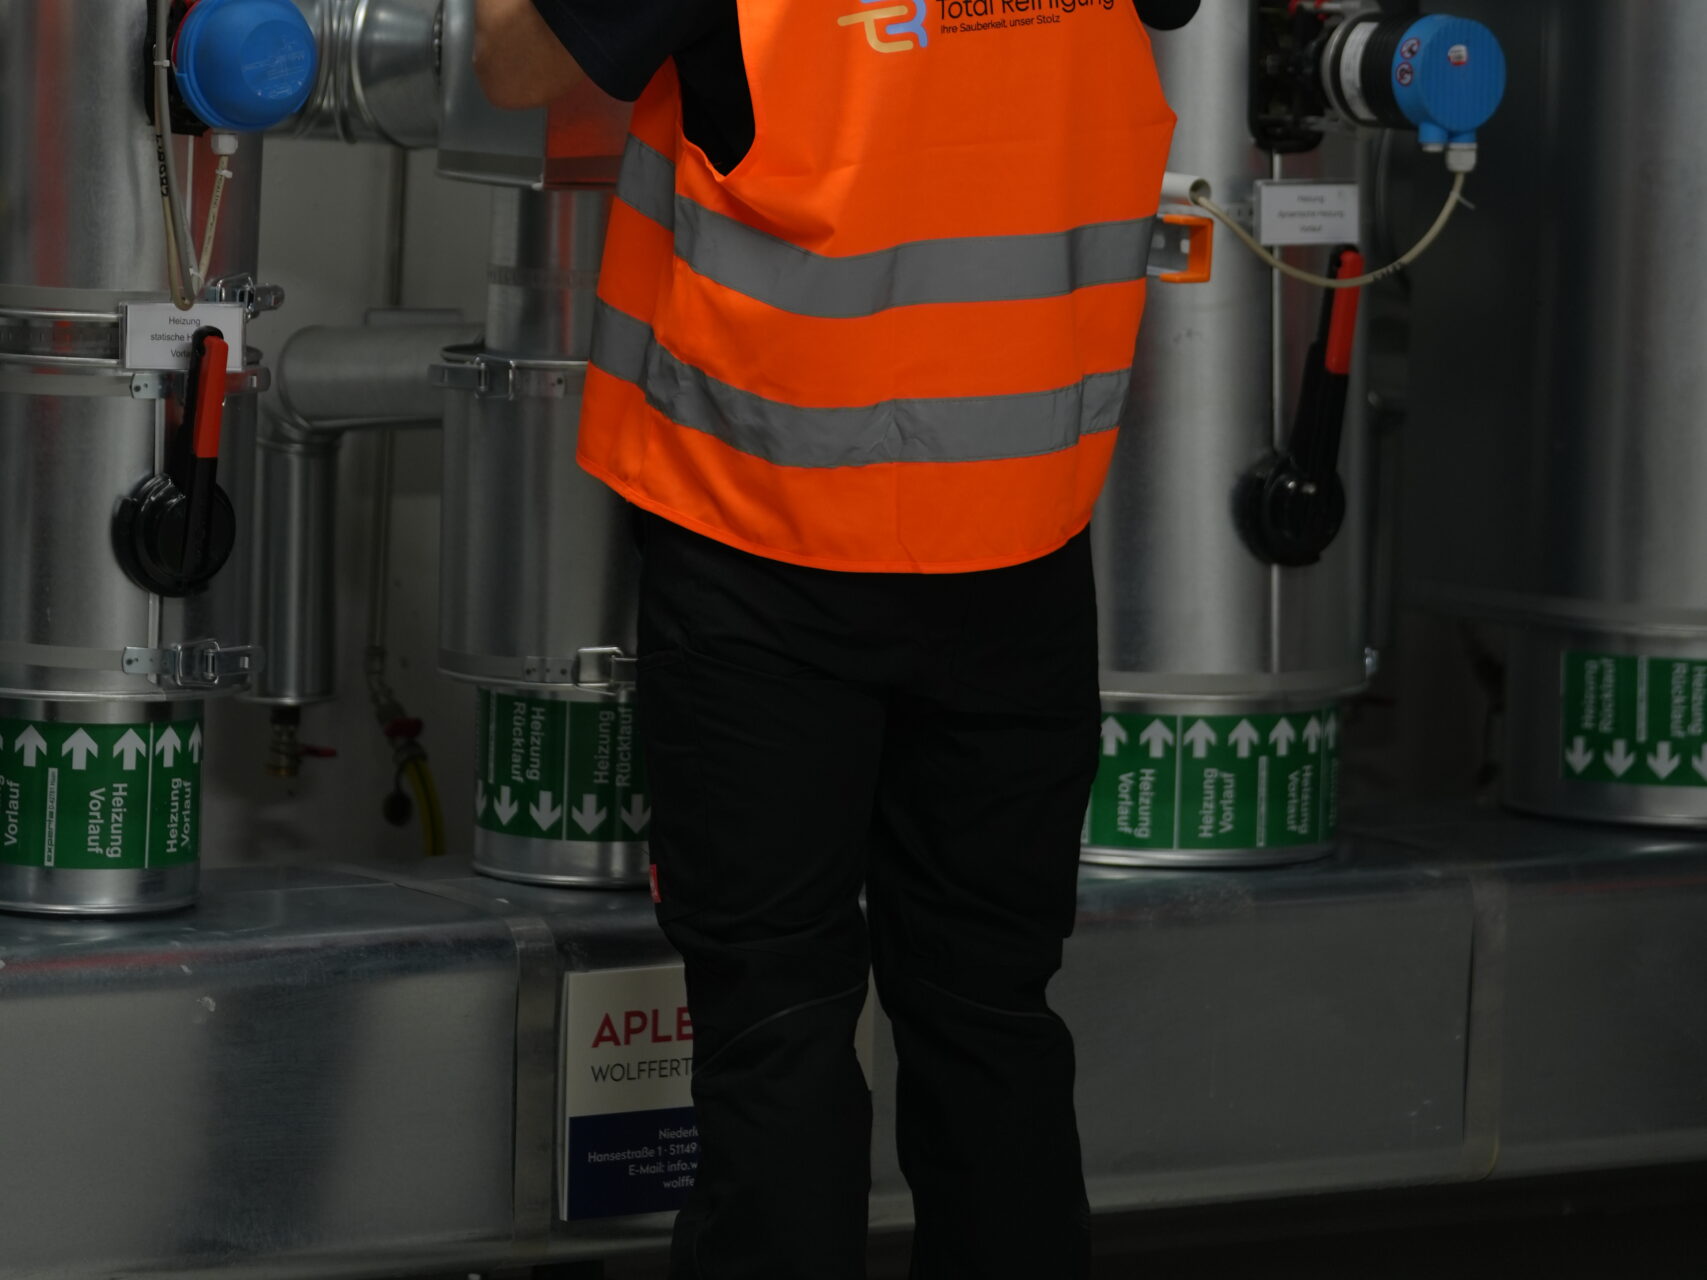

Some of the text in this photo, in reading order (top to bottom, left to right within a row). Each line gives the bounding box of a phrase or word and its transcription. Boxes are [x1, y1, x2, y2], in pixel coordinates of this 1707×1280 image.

[940, 14, 1060, 34] Ihre Sauberkeit, unser Stolz
[150, 333, 185, 342] statische
[168, 316, 201, 326] Heizung
[170, 349, 191, 358] Vorla
[510, 701, 527, 783] Rücklauf
[526, 706, 547, 781] Heizung
[593, 710, 616, 785] Heizung
[615, 706, 634, 788] Rücklauf
[4, 779, 21, 846] Vorlauf
[87, 787, 106, 855] Vorlauf
[105, 783, 128, 858] Heizung
[166, 777, 182, 853] Heizung
[180, 781, 192, 847] Vorlauf
[1117, 771, 1136, 835] Vorlauf
[1134, 768, 1157, 839] Heizung
[1198, 767, 1219, 839] Heizung
[1218, 770, 1236, 834] Vorlauf
[1286, 769, 1301, 832] Vorlauf
[1297, 764, 1313, 835] Heizung
[592, 1006, 695, 1048] APLE
[591, 1057, 696, 1082] WOLFFERT
[587, 1146, 656, 1163] Hansestraße
[669, 1141, 698, 1156] 51149
[658, 1125, 699, 1140] Niederl
[628, 1159, 699, 1176] E-Mail: info.w
[663, 1175, 695, 1189] wolffe
